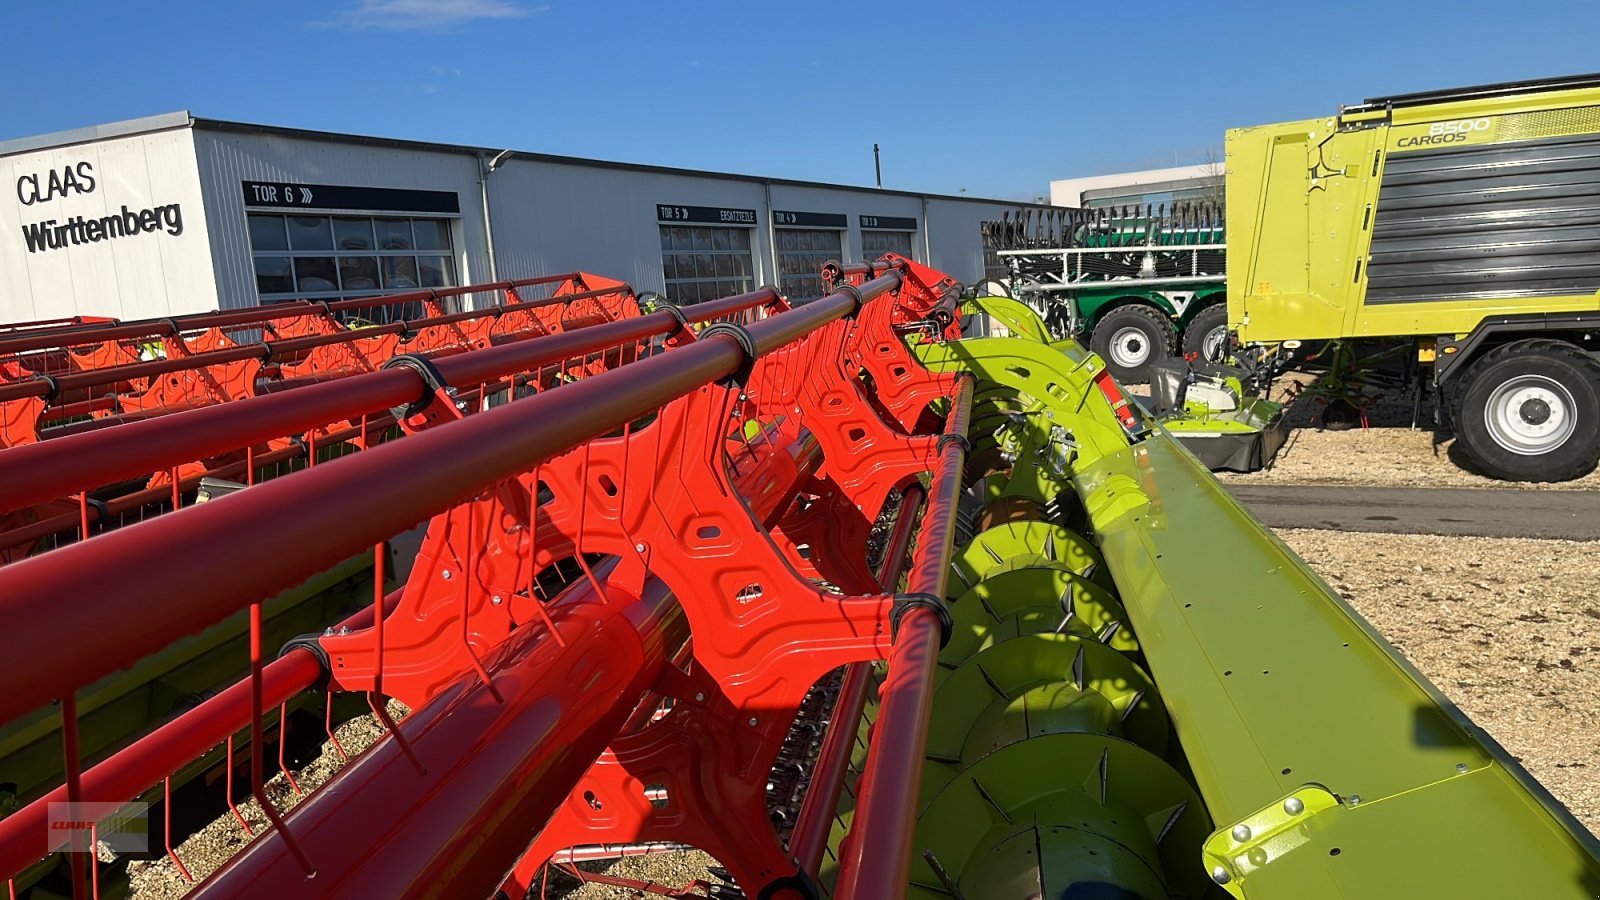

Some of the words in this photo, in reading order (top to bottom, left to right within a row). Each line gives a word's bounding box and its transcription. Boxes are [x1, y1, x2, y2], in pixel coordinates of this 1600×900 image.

[1429, 118, 1490, 136] 8500
[1397, 132, 1467, 147] CARGOS
[17, 161, 96, 206] CLAAS
[252, 185, 278, 202] TOR
[284, 186, 294, 203] 6
[661, 206, 673, 219] TOR
[675, 207, 680, 219] 5
[720, 210, 754, 222] ERSATZTEILE
[775, 212, 785, 223] TOR
[21, 203, 183, 253] Württemberg
